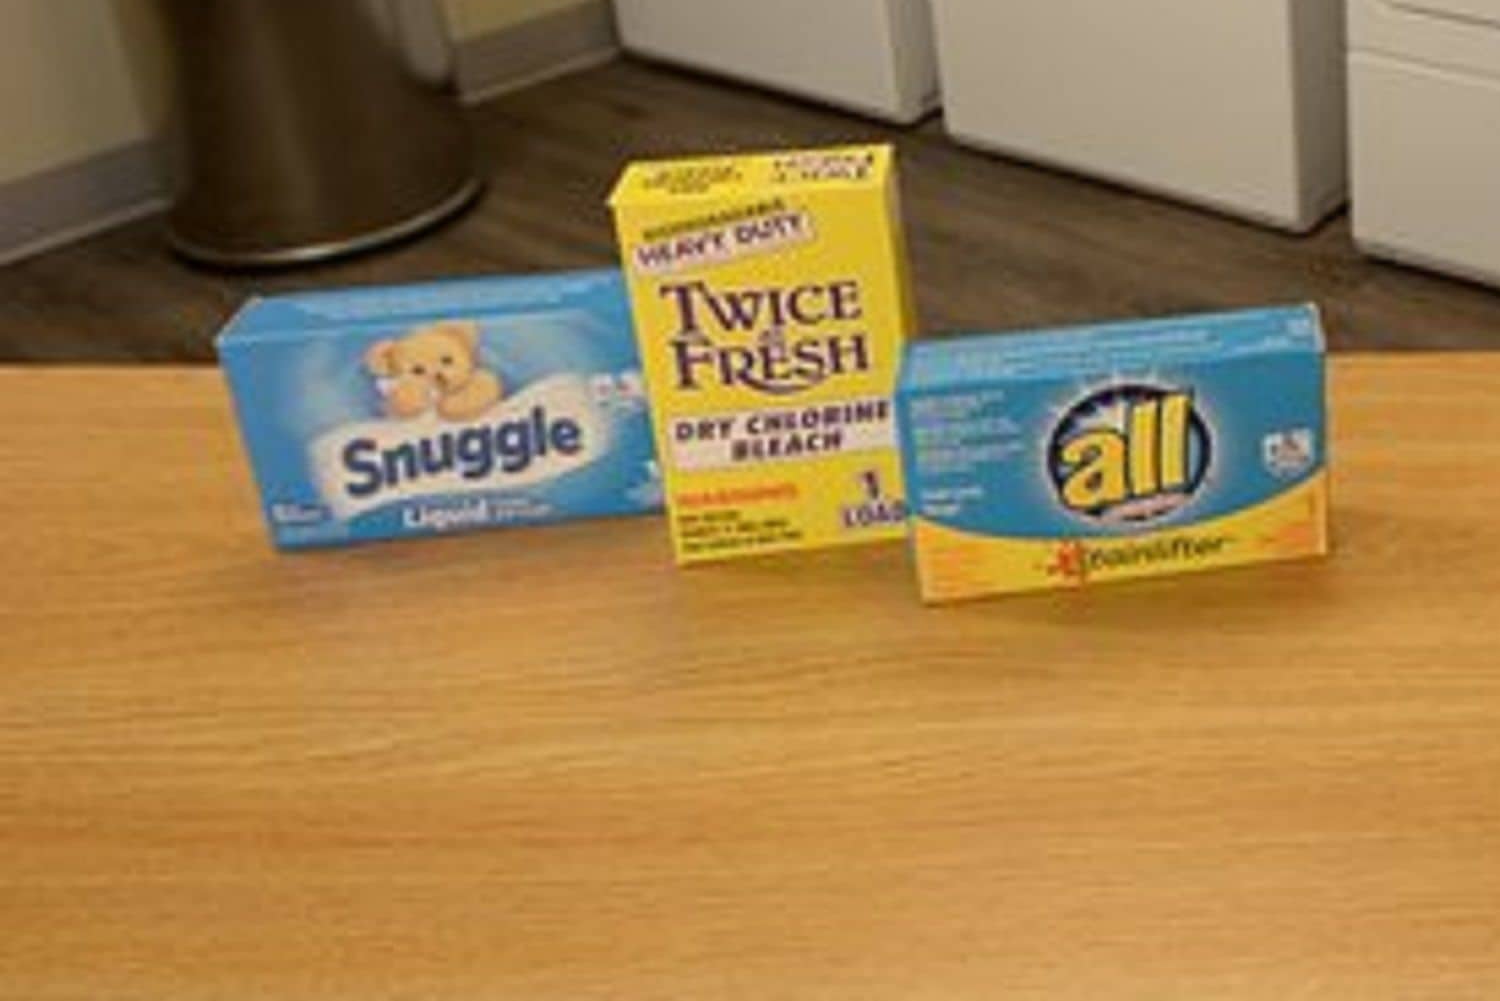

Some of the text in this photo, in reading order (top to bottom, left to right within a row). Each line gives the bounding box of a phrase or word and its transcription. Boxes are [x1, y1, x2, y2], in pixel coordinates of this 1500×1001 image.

[735, 213, 803, 244] DUTY
[659, 280, 863, 333] TWICE
[667, 336, 869, 396] FRESH
[676, 400, 889, 440] DRY CHLORINE
[342, 404, 583, 497] Snuggle
[731, 431, 842, 461] BLEACH
[1059, 394, 1191, 511] all
[402, 499, 487, 531] Liquid
